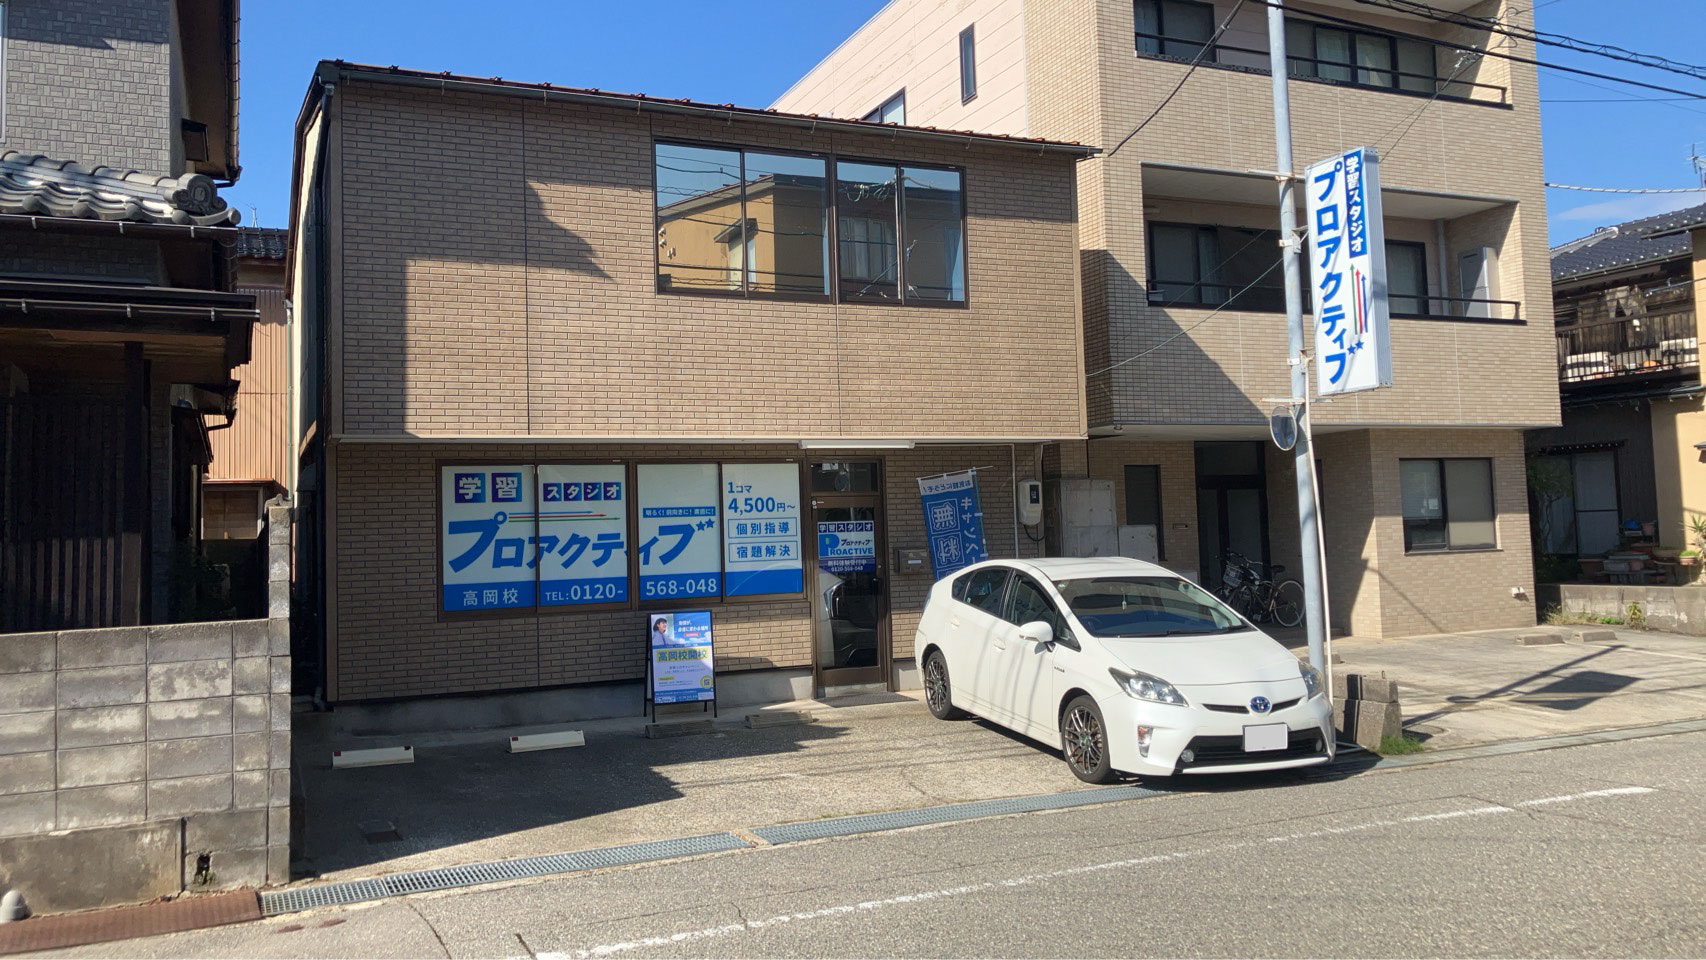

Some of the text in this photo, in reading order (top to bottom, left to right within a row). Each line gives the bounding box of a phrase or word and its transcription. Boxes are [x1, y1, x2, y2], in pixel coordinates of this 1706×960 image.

[1345, 157, 1363, 253] 学習スタジオ
[1314, 161, 1364, 385] プロアクティブ
[458, 476, 620, 500] 学習 スタジオ
[727, 482, 752, 494] 1コマ
[736, 522, 790, 535] 個別指導
[819, 522, 873, 532] 学習スタジオ
[448, 511, 715, 573] プロアクティブ
[736, 544, 791, 558] 宿題解決
[819, 534, 873, 556] PROACTIVE
[840, 538, 873, 546] プロアクティブ
[463, 588, 519, 607] 高岡校
[545, 578, 717, 601] TEL:0120- 568-048
[658, 650, 707, 662] 高岡校開校
